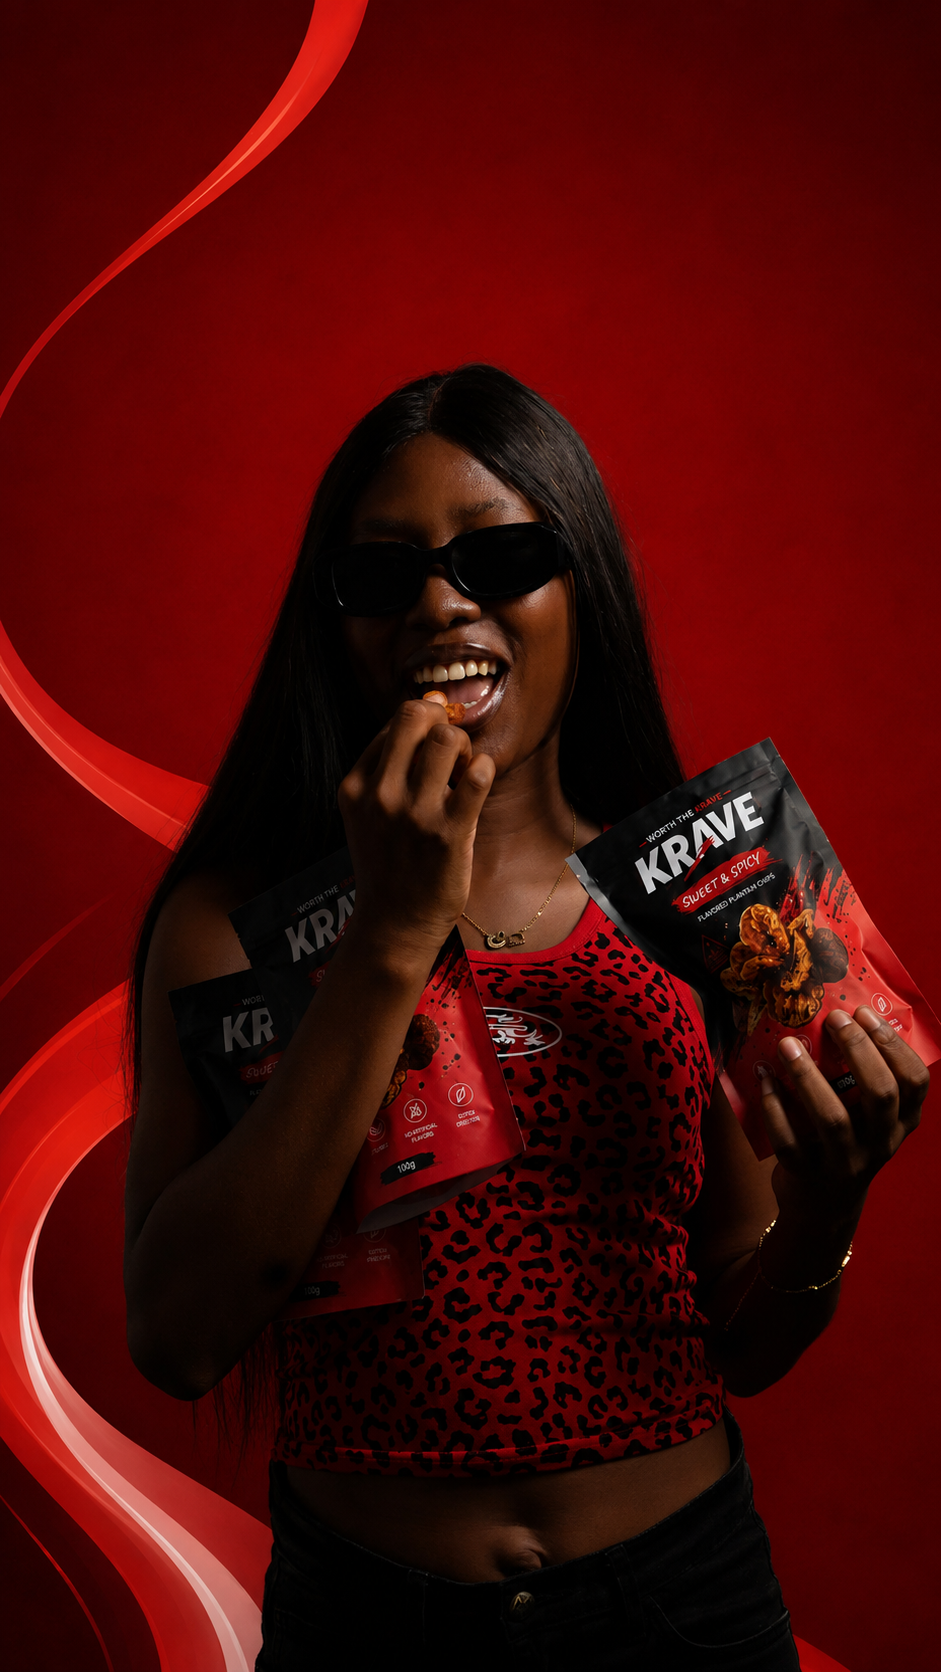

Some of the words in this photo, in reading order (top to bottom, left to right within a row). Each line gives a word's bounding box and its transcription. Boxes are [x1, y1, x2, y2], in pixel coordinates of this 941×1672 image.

[634, 791, 765, 895] KRAVE
[646, 817, 677, 843] WORTH
[676, 808, 695, 824] THE
[694, 792, 723, 813] KRAVE
[297, 894, 324, 914] WORTH
[324, 884, 340, 898] THE
[682, 877, 719, 908] SWEET
[720, 873, 731, 884] &
[730, 851, 761, 878] SPICY
[284, 889, 356, 964] KRA
[397, 1160, 416, 1173] 100g
